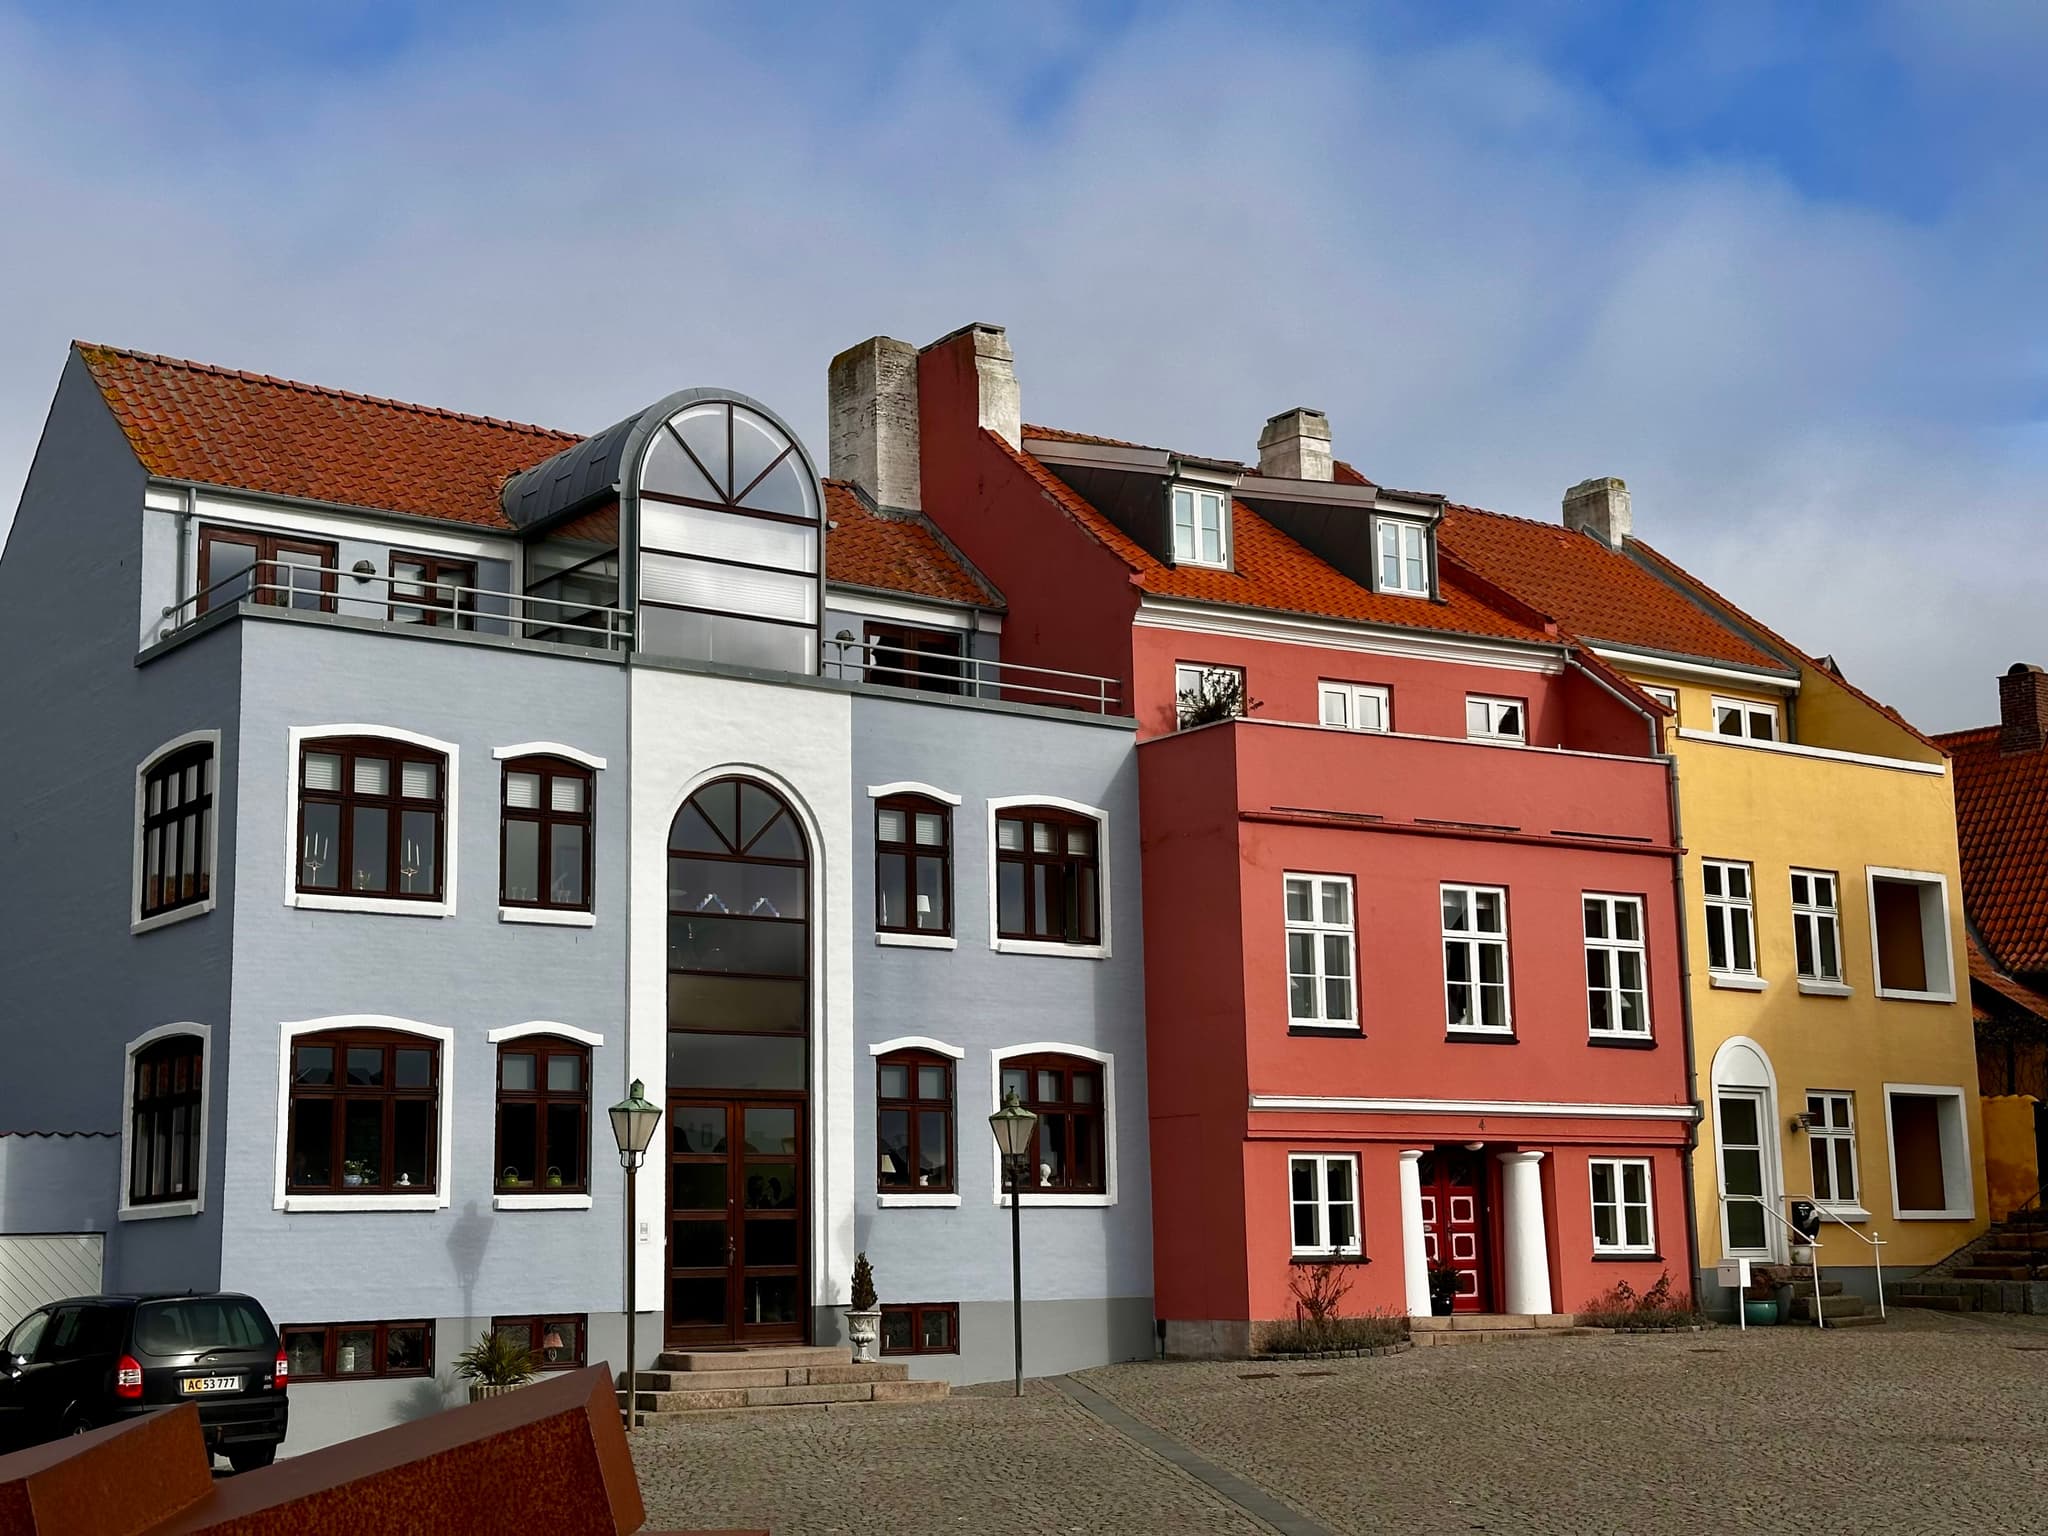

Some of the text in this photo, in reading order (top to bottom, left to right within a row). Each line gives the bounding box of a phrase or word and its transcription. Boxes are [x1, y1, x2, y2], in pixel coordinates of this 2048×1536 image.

[188, 1377, 235, 1391] AC 53 777
